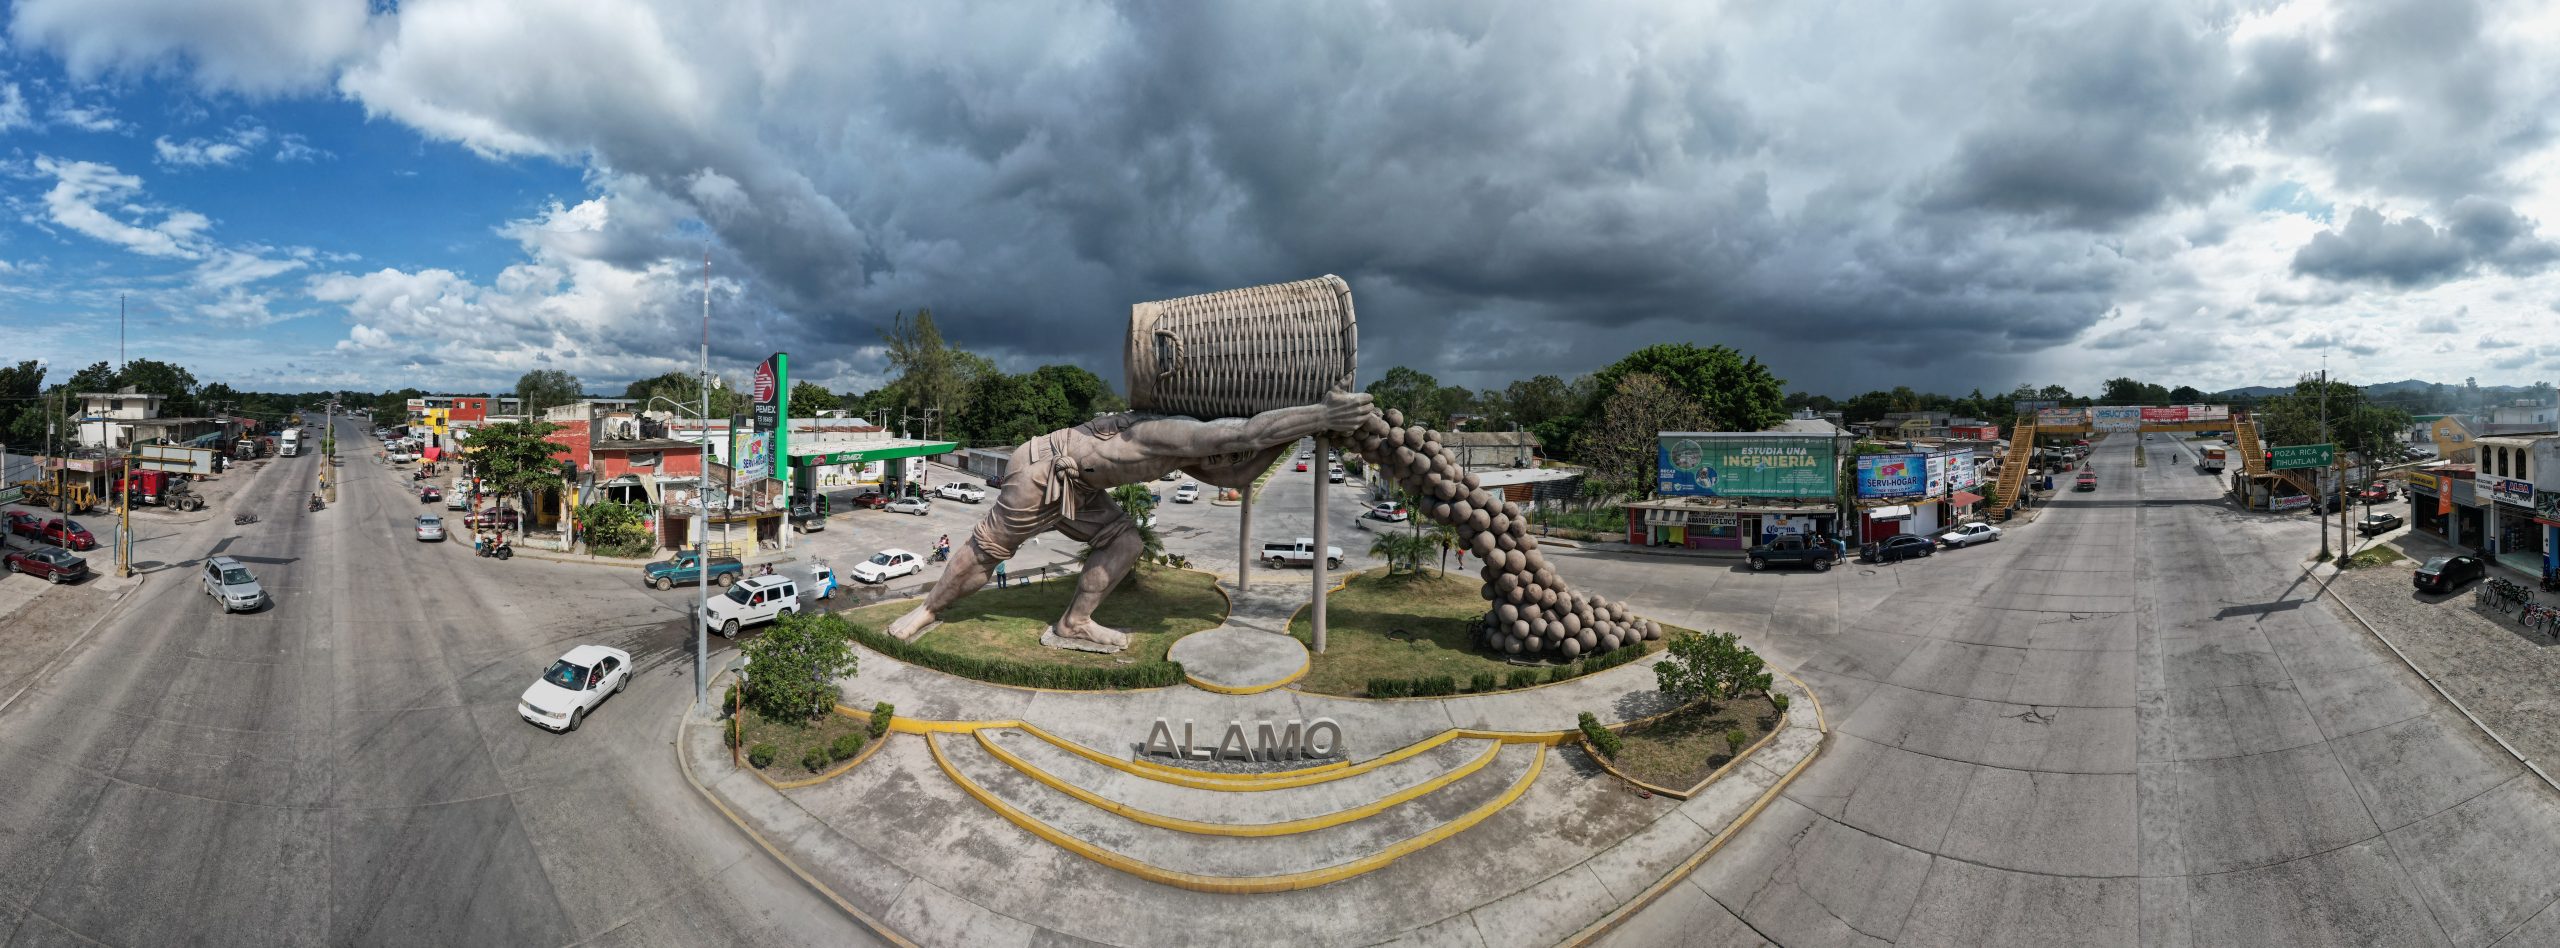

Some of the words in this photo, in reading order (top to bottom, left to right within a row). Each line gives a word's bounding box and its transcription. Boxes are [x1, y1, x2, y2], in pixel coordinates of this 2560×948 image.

[755, 405, 776, 414] PEMEX
[1741, 447, 1784, 455] ESTUDIA
[1786, 447, 1807, 455] UNA
[2274, 450, 2296, 458] POZA
[2299, 448, 2318, 456] RICA
[835, 453, 864, 462] PEMEX
[2275, 457, 2317, 467] TIHUATLAN
[1867, 476, 1917, 488] SERVI-HOGAR
[1687, 517, 1719, 525] ABARROTES
[1765, 524, 1796, 535] Cona
[1142, 716, 1343, 763] ALAMO
